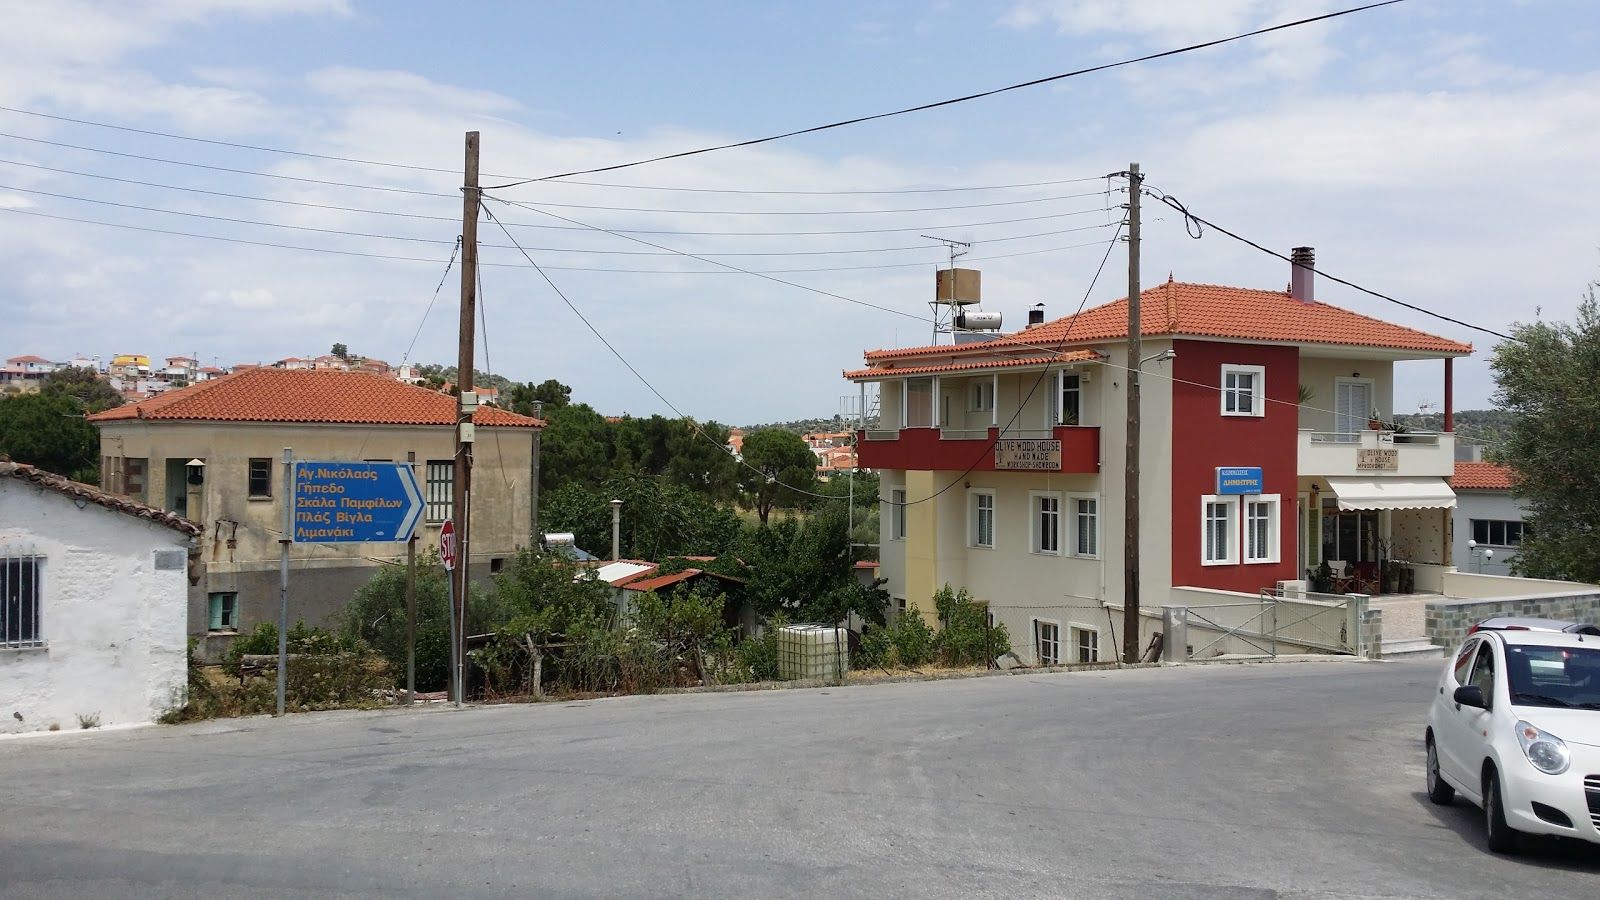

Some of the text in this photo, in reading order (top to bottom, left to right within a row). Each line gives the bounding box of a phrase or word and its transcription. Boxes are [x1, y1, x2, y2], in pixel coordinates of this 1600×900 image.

[995, 441, 1060, 452] OLIVE WOOD HOUSE
[1383, 449, 1398, 457] WOOD
[297, 482, 345, 495] Γήπεδο
[297, 496, 403, 510] Σκάλα Παμφίλων
[297, 511, 373, 525] Πλάζ Βίγλα
[297, 525, 354, 539] Λιμανάκι
[441, 533, 456, 558] ST
